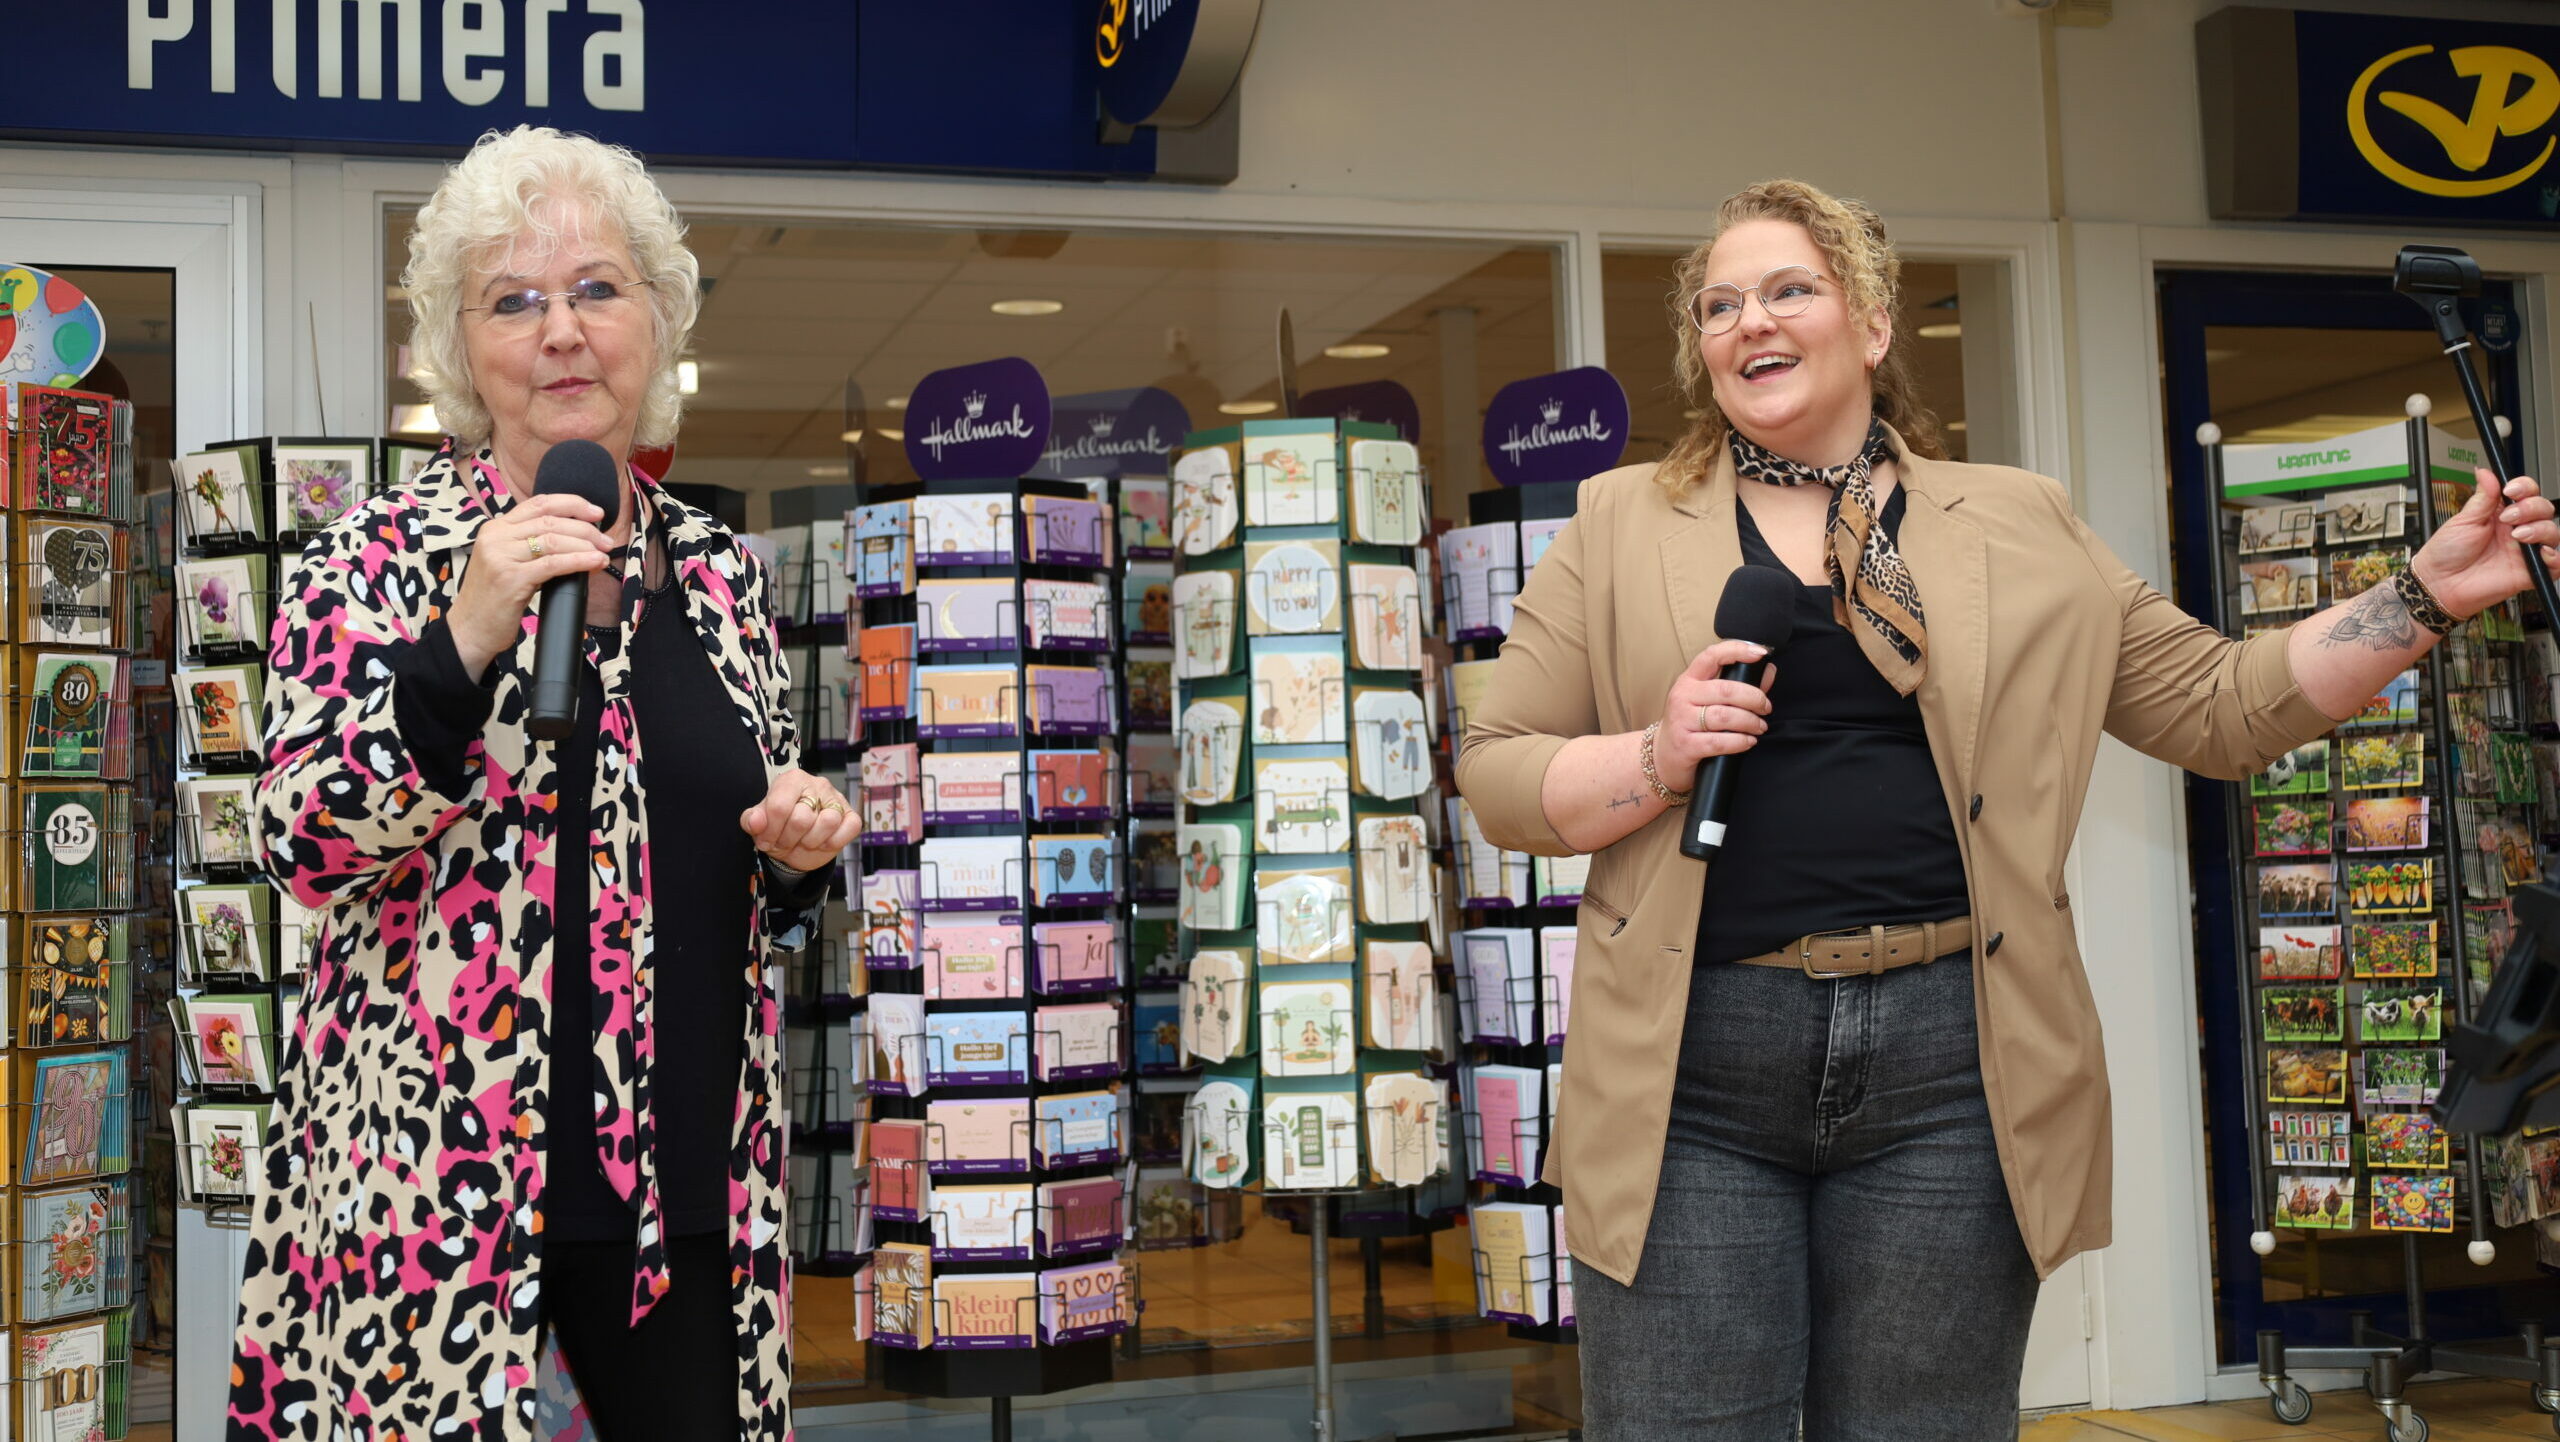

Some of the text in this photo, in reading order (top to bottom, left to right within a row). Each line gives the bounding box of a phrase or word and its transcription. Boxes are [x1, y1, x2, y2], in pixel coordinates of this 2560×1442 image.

[127, 0, 646, 112] Primera
[52, 406, 96, 450] 75
[920, 404, 1034, 462] Hallmark
[1499, 409, 1611, 467] Hallmark
[74, 540, 104, 572] 75
[62, 681, 89, 701] 80
[53, 814, 89, 845] 85
[954, 1294, 1017, 1315] klein
[958, 1313, 1015, 1334] kind
[41, 1364, 99, 1412] 100
